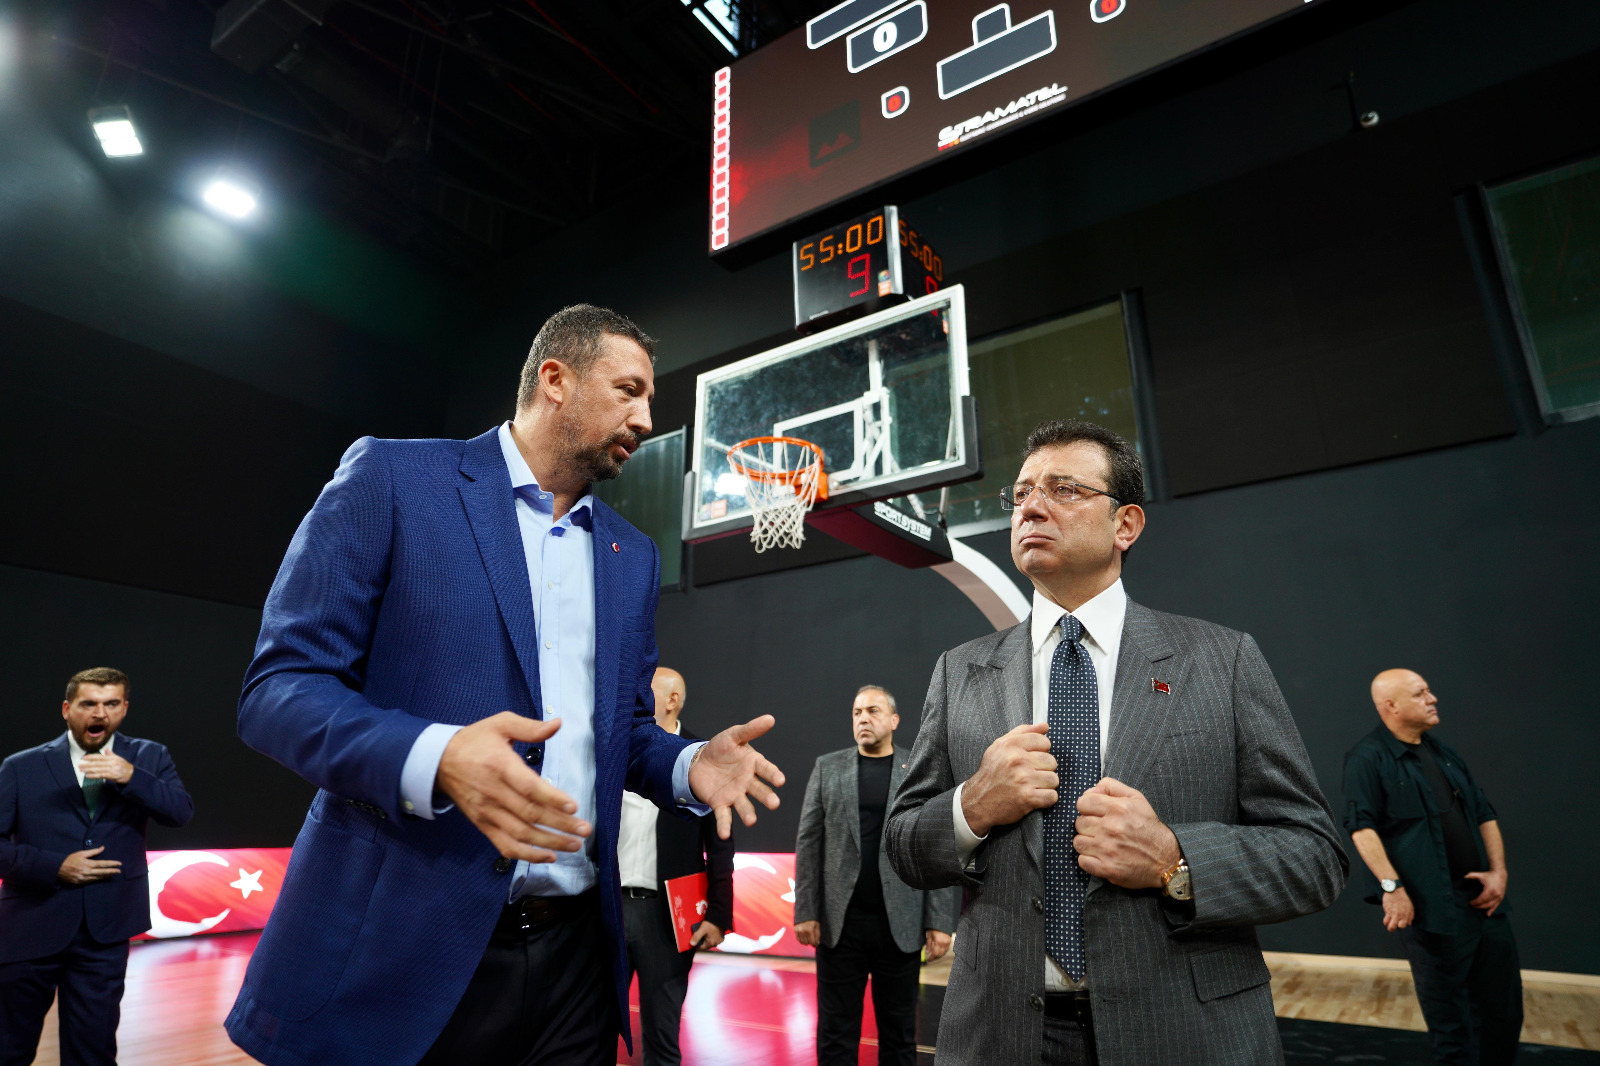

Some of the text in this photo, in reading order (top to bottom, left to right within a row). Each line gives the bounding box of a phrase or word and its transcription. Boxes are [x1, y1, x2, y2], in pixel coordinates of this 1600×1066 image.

[873, 21, 898, 53] 0
[938, 83, 1069, 147] STRAMATEL
[800, 215, 884, 271] 55:00
[898, 219, 943, 282] 55:00
[847, 253, 871, 298] 9
